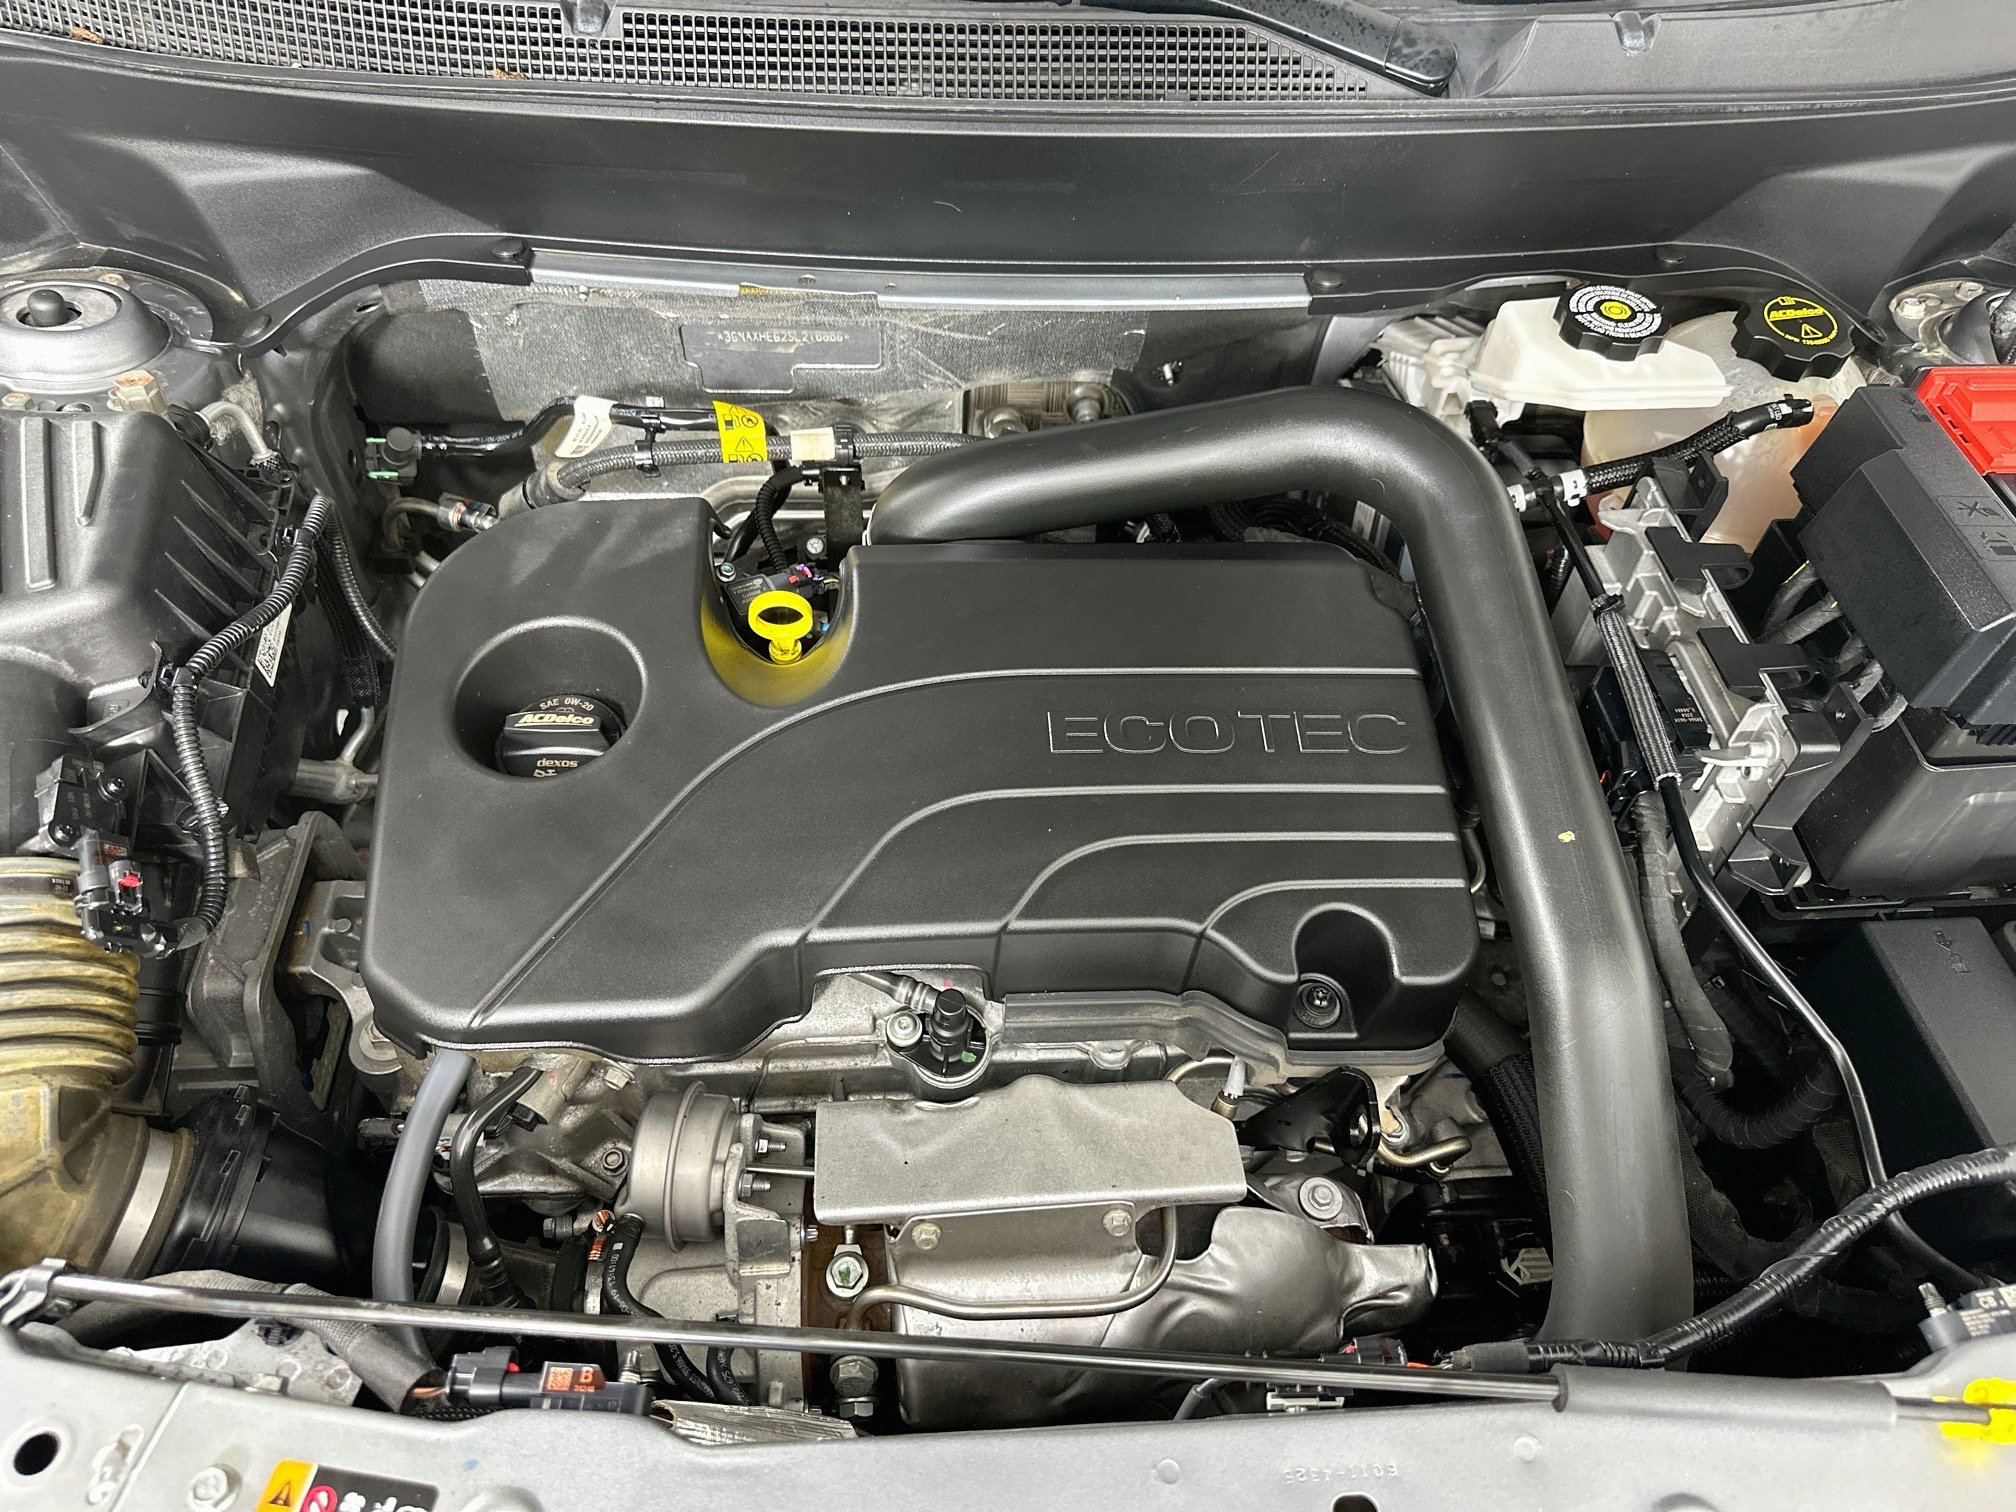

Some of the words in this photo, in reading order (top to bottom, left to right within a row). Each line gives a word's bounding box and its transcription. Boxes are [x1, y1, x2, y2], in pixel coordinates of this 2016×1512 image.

[1769, 307, 1824, 318] ACDelco
[540, 699, 560, 710] SAE
[564, 697, 595, 712] 0W-20
[518, 714, 595, 725] ACDelco
[1048, 710, 1407, 754] ECOTEC
[537, 758, 578, 768] dexos
[579, 1366, 594, 1384] B
